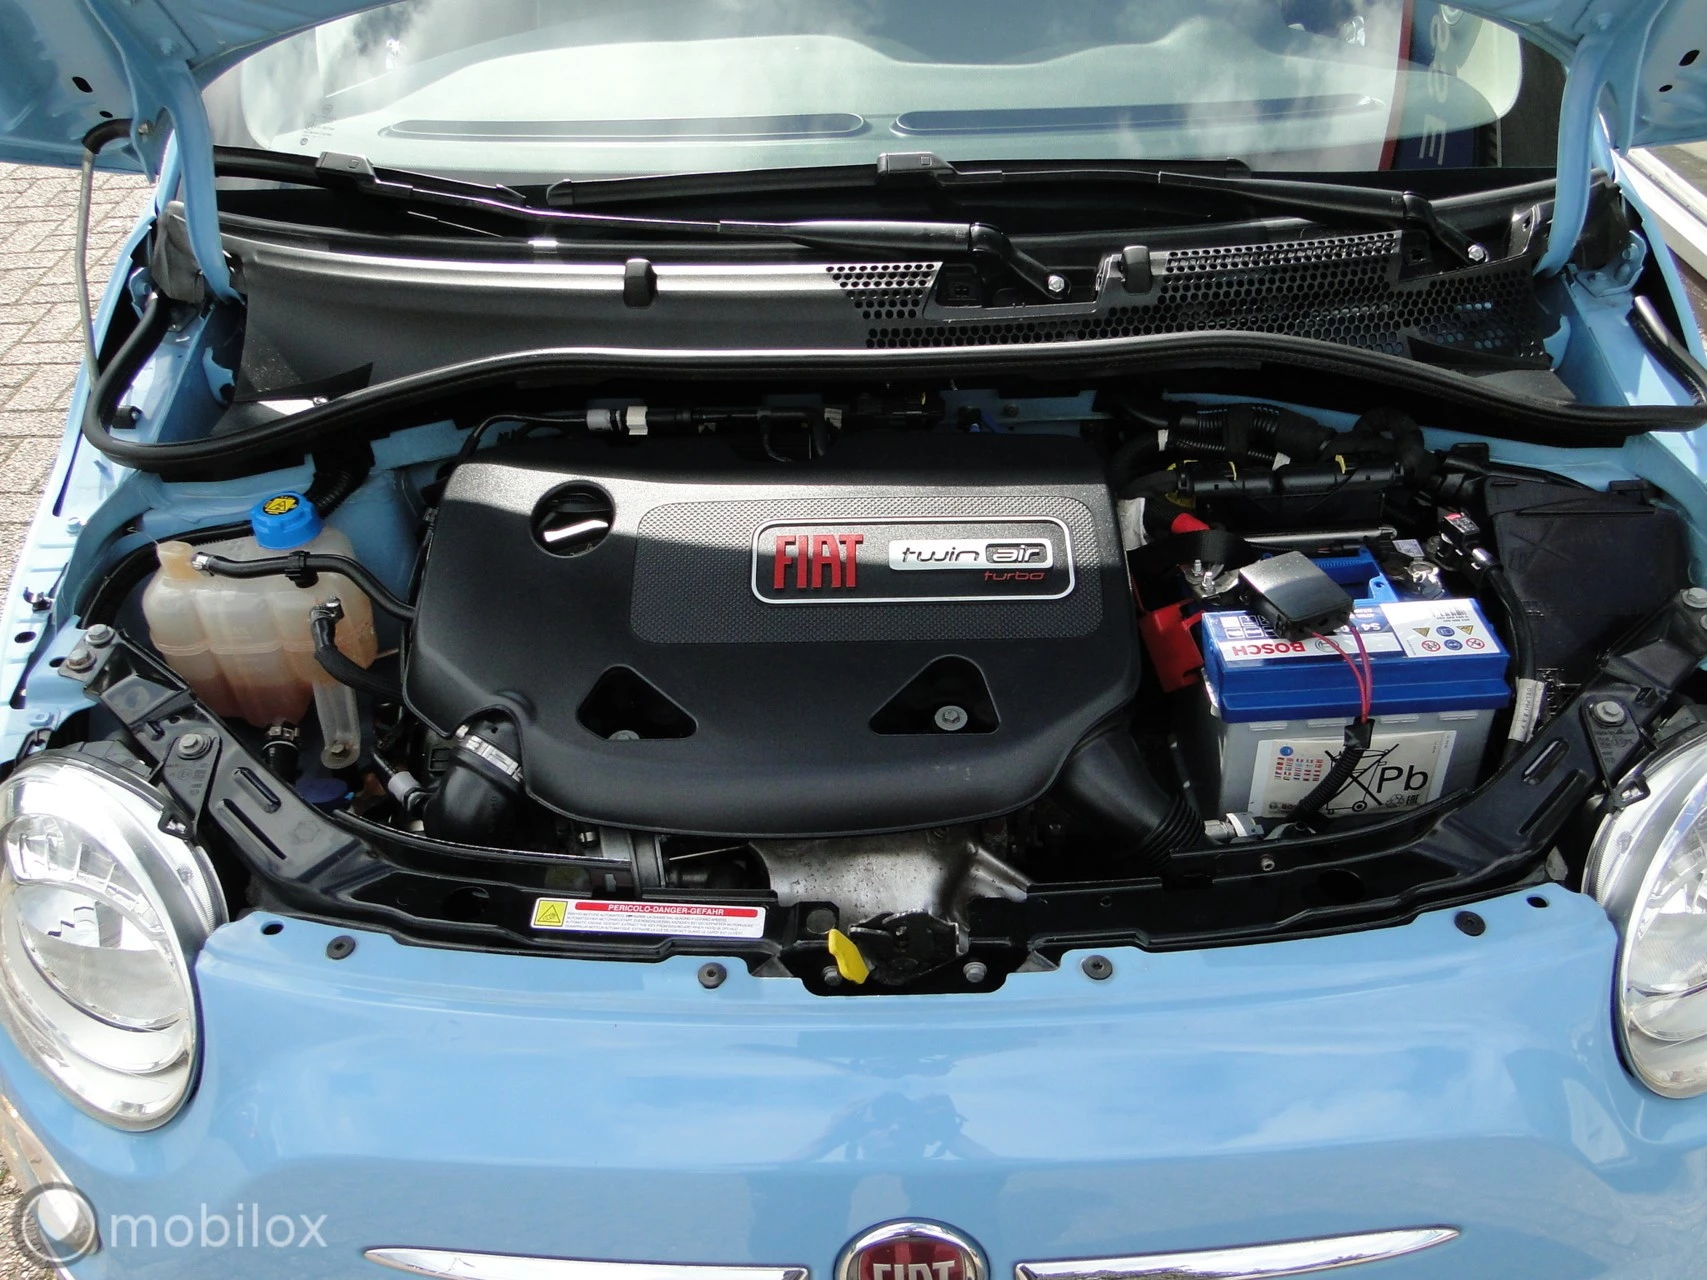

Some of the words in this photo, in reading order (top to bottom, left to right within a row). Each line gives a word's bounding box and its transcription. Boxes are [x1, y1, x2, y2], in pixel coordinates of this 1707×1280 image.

[773, 534, 864, 589] FIAT
[901, 546, 980, 563] twin
[992, 544, 1041, 563] air
[983, 571, 1045, 581] turbo
[1232, 641, 1306, 656] BOSCH
[1376, 765, 1429, 793] Pb
[607, 904, 724, 916] PERICOLO-DANGER-GEFAHR
